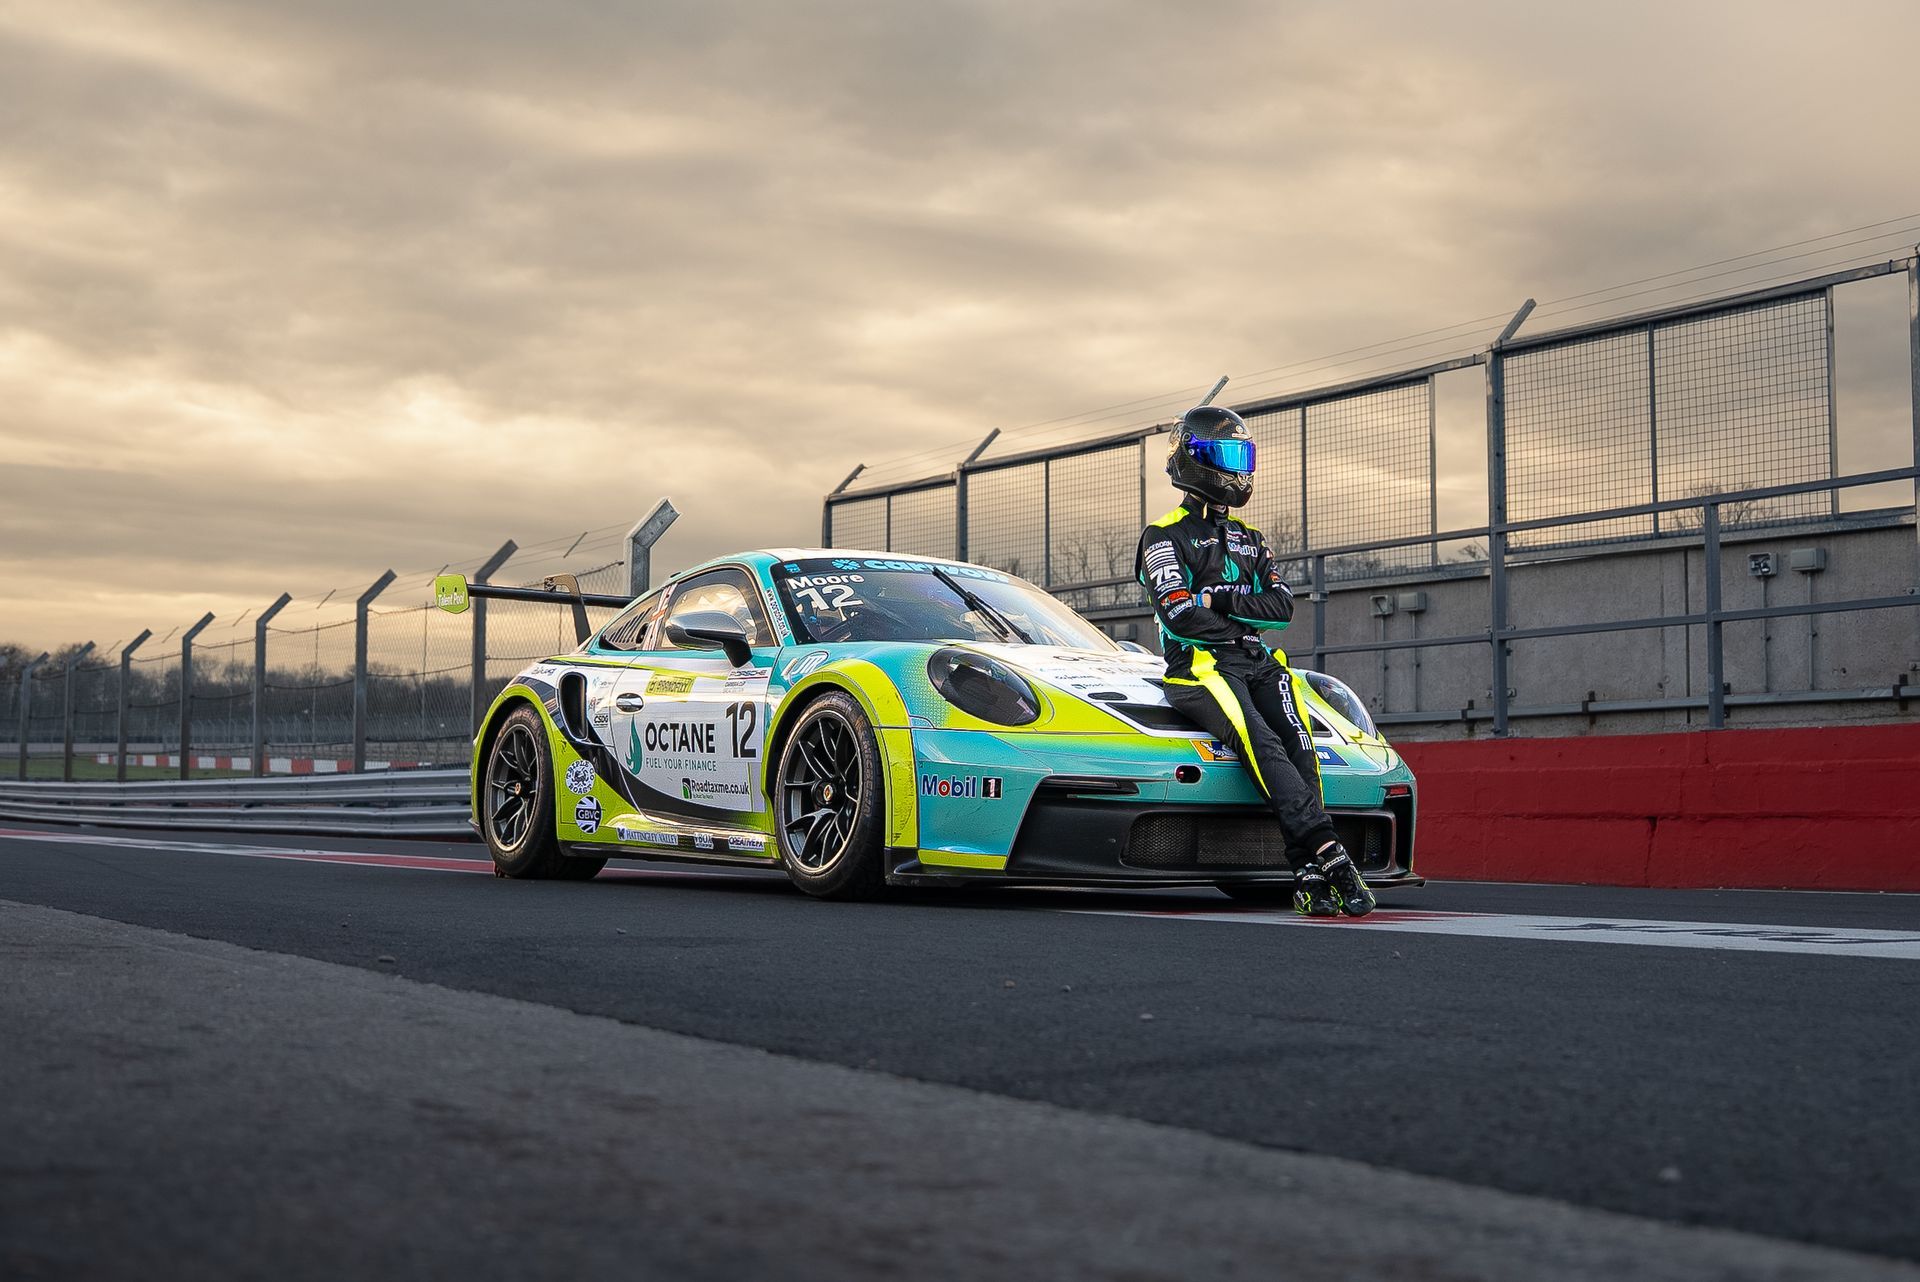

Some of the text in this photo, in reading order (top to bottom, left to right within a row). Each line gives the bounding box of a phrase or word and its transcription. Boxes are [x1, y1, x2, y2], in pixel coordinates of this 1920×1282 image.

[786, 574, 865, 590] Moore
[1149, 564, 1183, 589] 75
[795, 584, 864, 611] 12
[1278, 673, 1312, 751] PORSCHE
[645, 722, 716, 754] OCTANE
[725, 700, 757, 758] 12
[646, 757, 717, 772] FUEL YOUR FINANCE
[691, 779, 750, 796] Roadtaxme.co.uk
[921, 773, 978, 799] Mobil
[577, 809, 600, 820] GBVC
